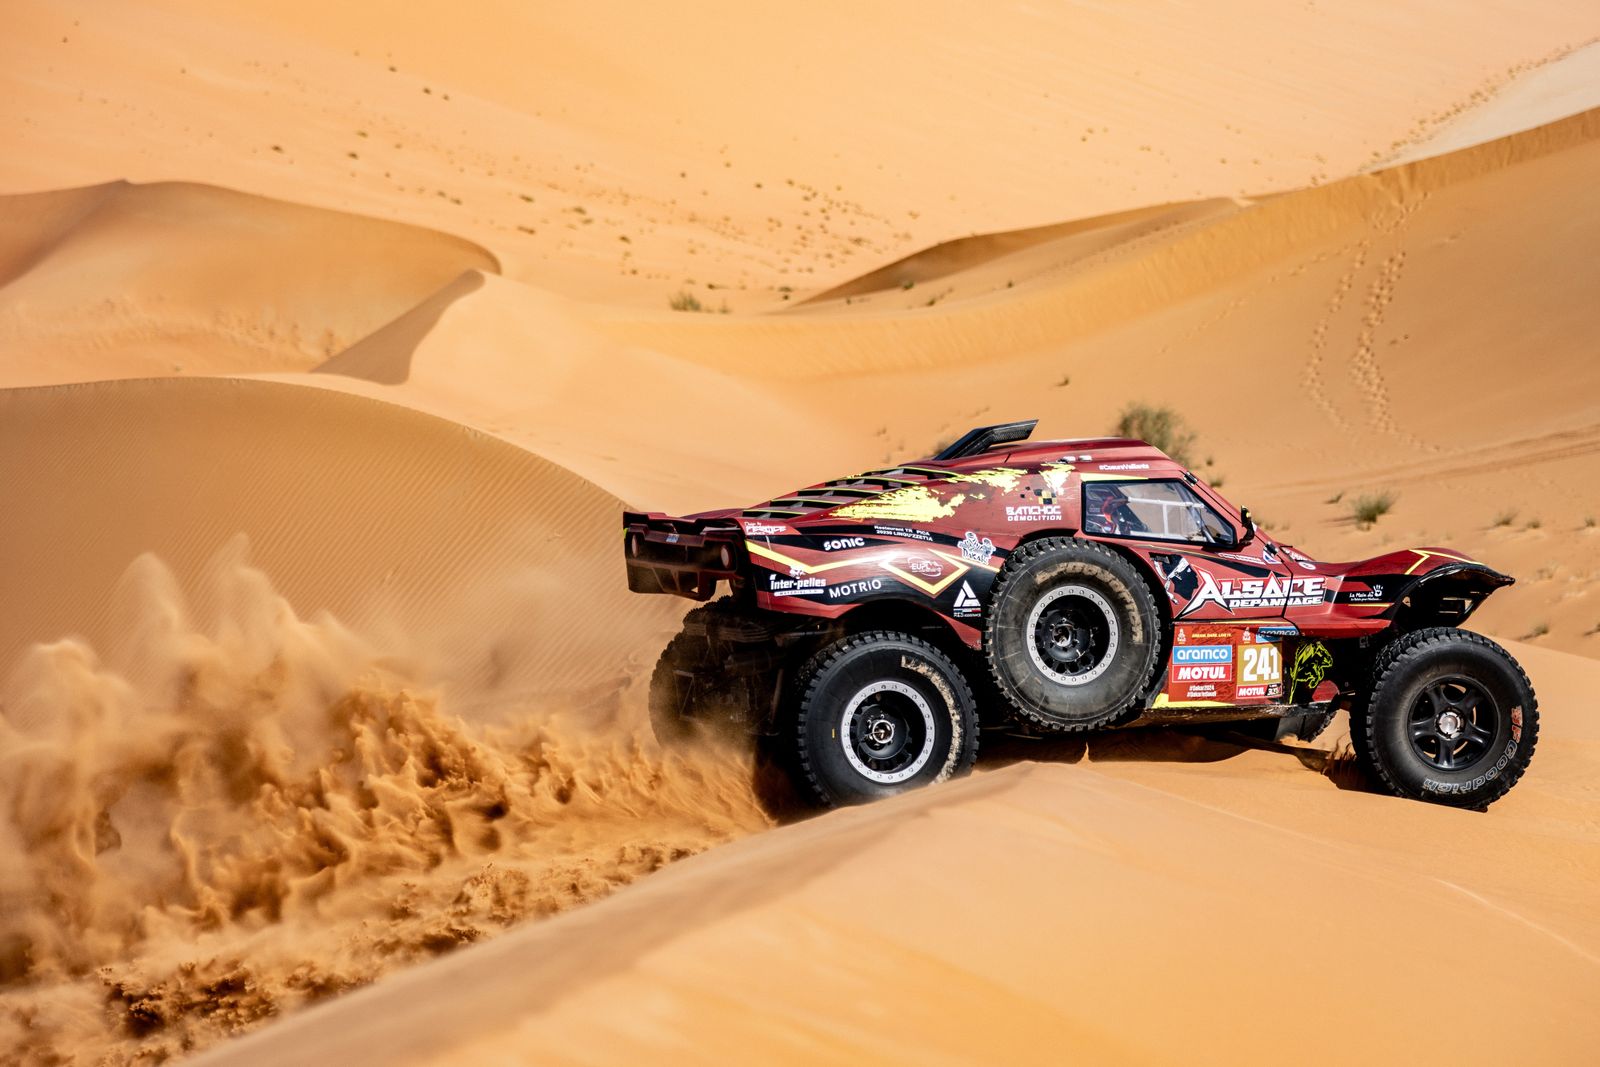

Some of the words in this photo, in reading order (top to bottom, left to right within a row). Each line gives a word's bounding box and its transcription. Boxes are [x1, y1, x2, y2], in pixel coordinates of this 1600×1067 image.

[828, 579, 882, 599] MOTRIO
[1181, 570, 1326, 615] ALSACE
[1177, 649, 1228, 661] aramco
[1242, 646, 1280, 682] 241
[1177, 666, 1227, 680] MOTUL
[1238, 687, 1265, 697] MOTUL
